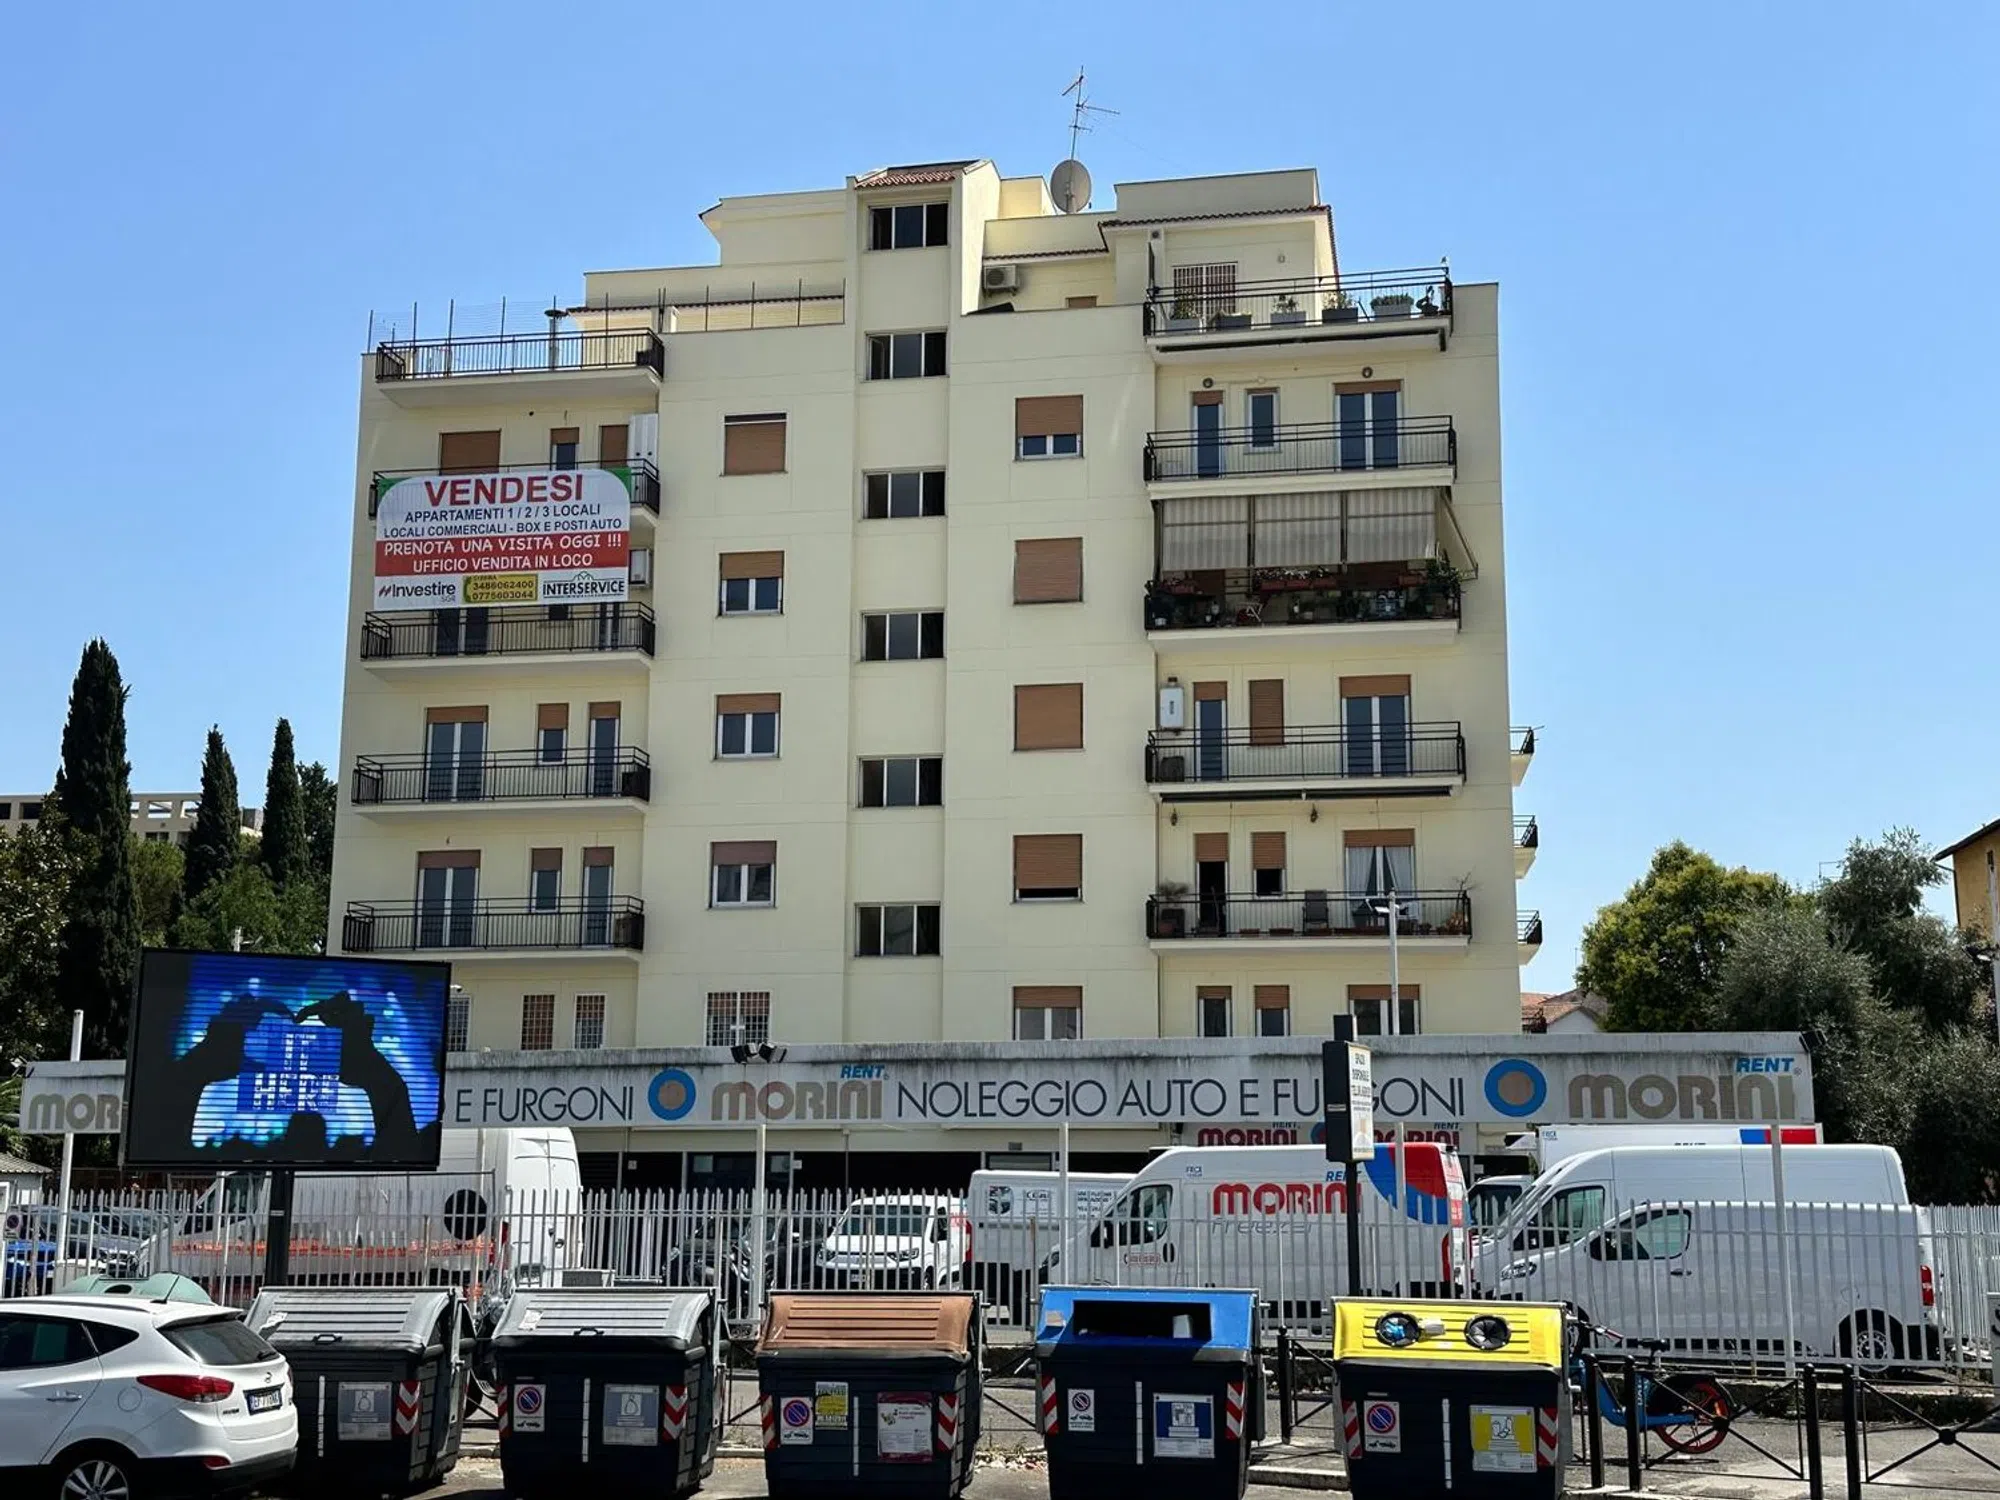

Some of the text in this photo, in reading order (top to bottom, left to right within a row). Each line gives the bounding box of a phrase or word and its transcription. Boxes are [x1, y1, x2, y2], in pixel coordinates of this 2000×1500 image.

[425, 473, 583, 507] VENDESI
[405, 507, 504, 523] APPARTAMENTI
[507, 507, 513, 518] 1
[525, 507, 531, 518] 2
[543, 506, 550, 517] 3
[553, 503, 600, 517] LOCALI
[384, 526, 425, 539] LOCALI
[428, 523, 507, 537] COMMERCIALI
[517, 521, 540, 534] BOX
[544, 521, 552, 532] E
[555, 519, 589, 532] POSTI
[590, 518, 621, 530] AUTO
[385, 533, 622, 557] PRENOTA UNA VISITA OGGI !!!
[413, 553, 593, 573] UFFICIO VENDITA IN LOCO
[392, 581, 456, 597] Investire
[543, 579, 625, 596] INTERSERVICE
[840, 1065, 885, 1079] RENT
[1736, 1057, 1795, 1073] RENT
[456, 1086, 633, 1122] E FURGONI
[711, 1081, 883, 1121] MORINI
[898, 1077, 1464, 1118] NOLEGGIO AUTO E FUONI
[1568, 1074, 1796, 1120] MORINI
[28, 1093, 120, 1130] MOR
